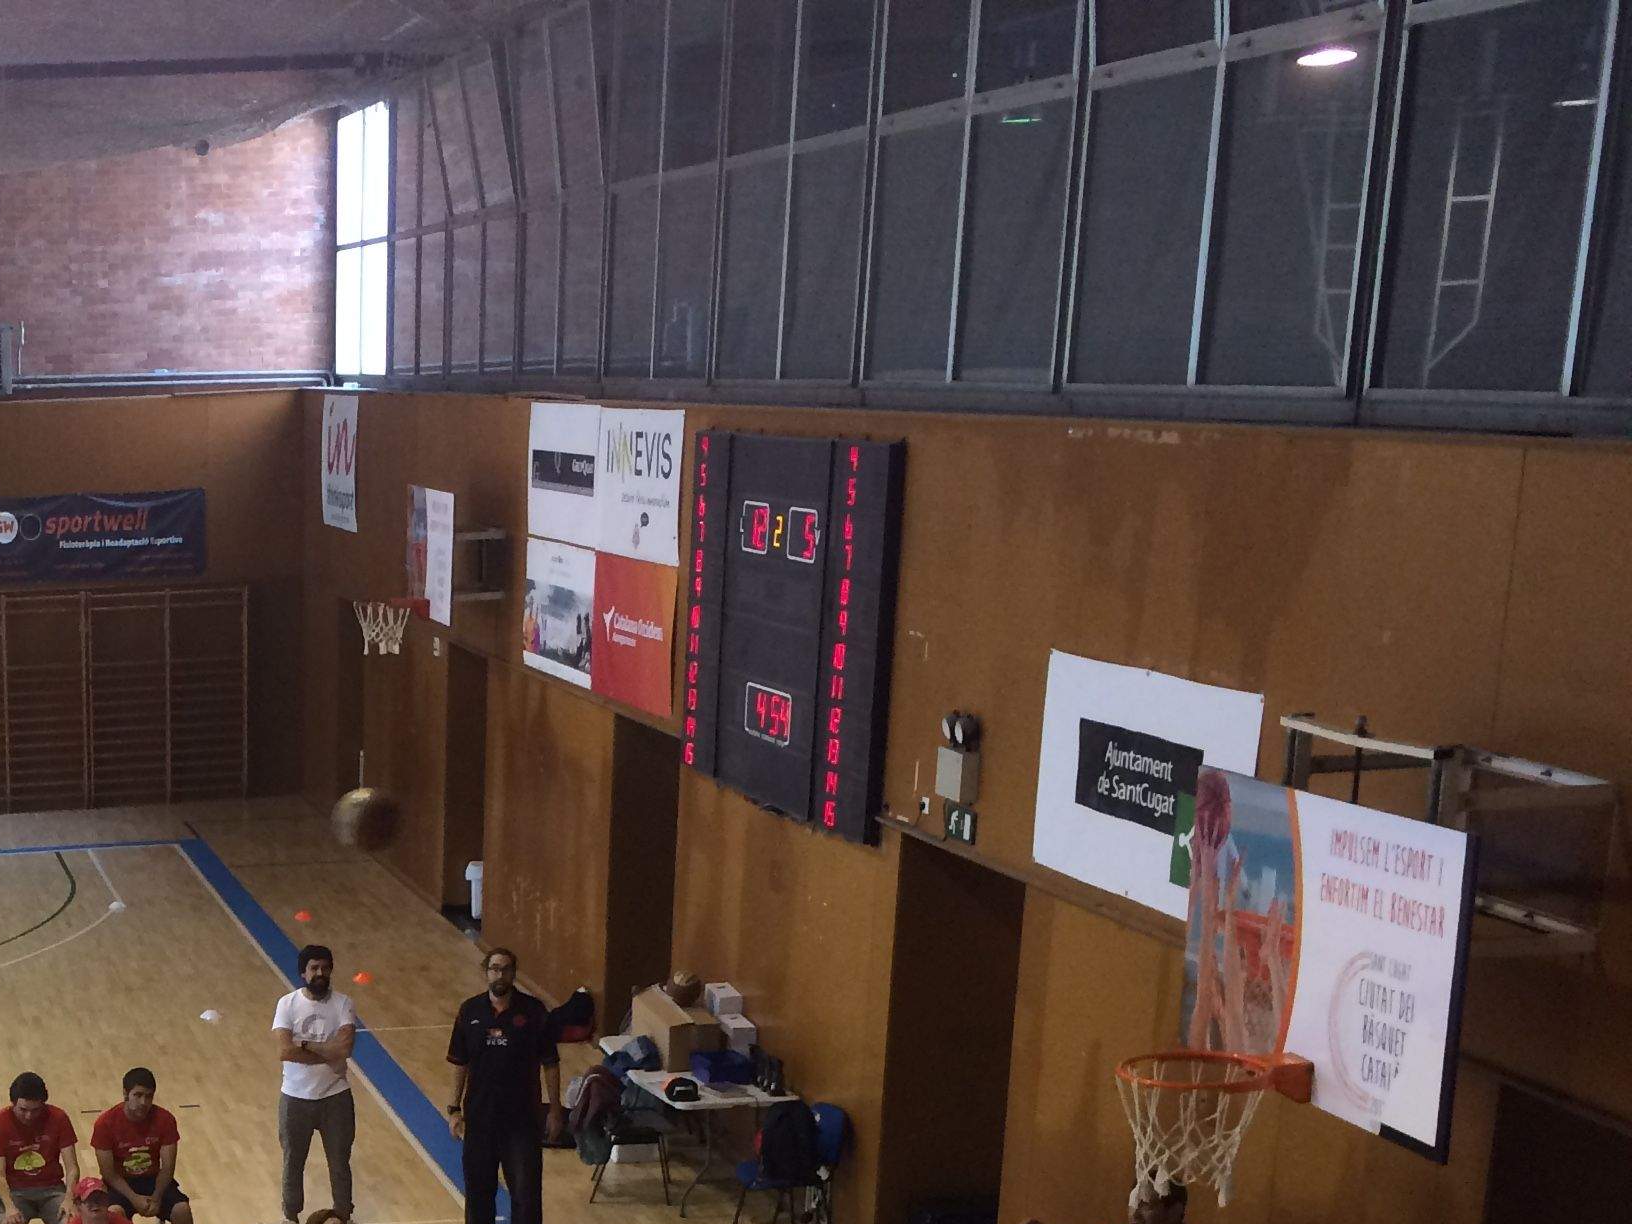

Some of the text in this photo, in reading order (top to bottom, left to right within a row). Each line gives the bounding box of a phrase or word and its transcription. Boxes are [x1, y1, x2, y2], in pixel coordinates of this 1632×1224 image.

[45, 507, 149, 537] sportwell
[773, 515, 783, 548] 2
[1105, 741, 1173, 782] Ajuntament
[1097, 770, 1110, 795] de
[1330, 828, 1380, 869] IMPULSEM
[1384, 841, 1434, 881] L'ESPORT
[1321, 872, 1446, 939] ENFORTIM EL BENESTAR
[1359, 978, 1396, 1014] CIUTAT
